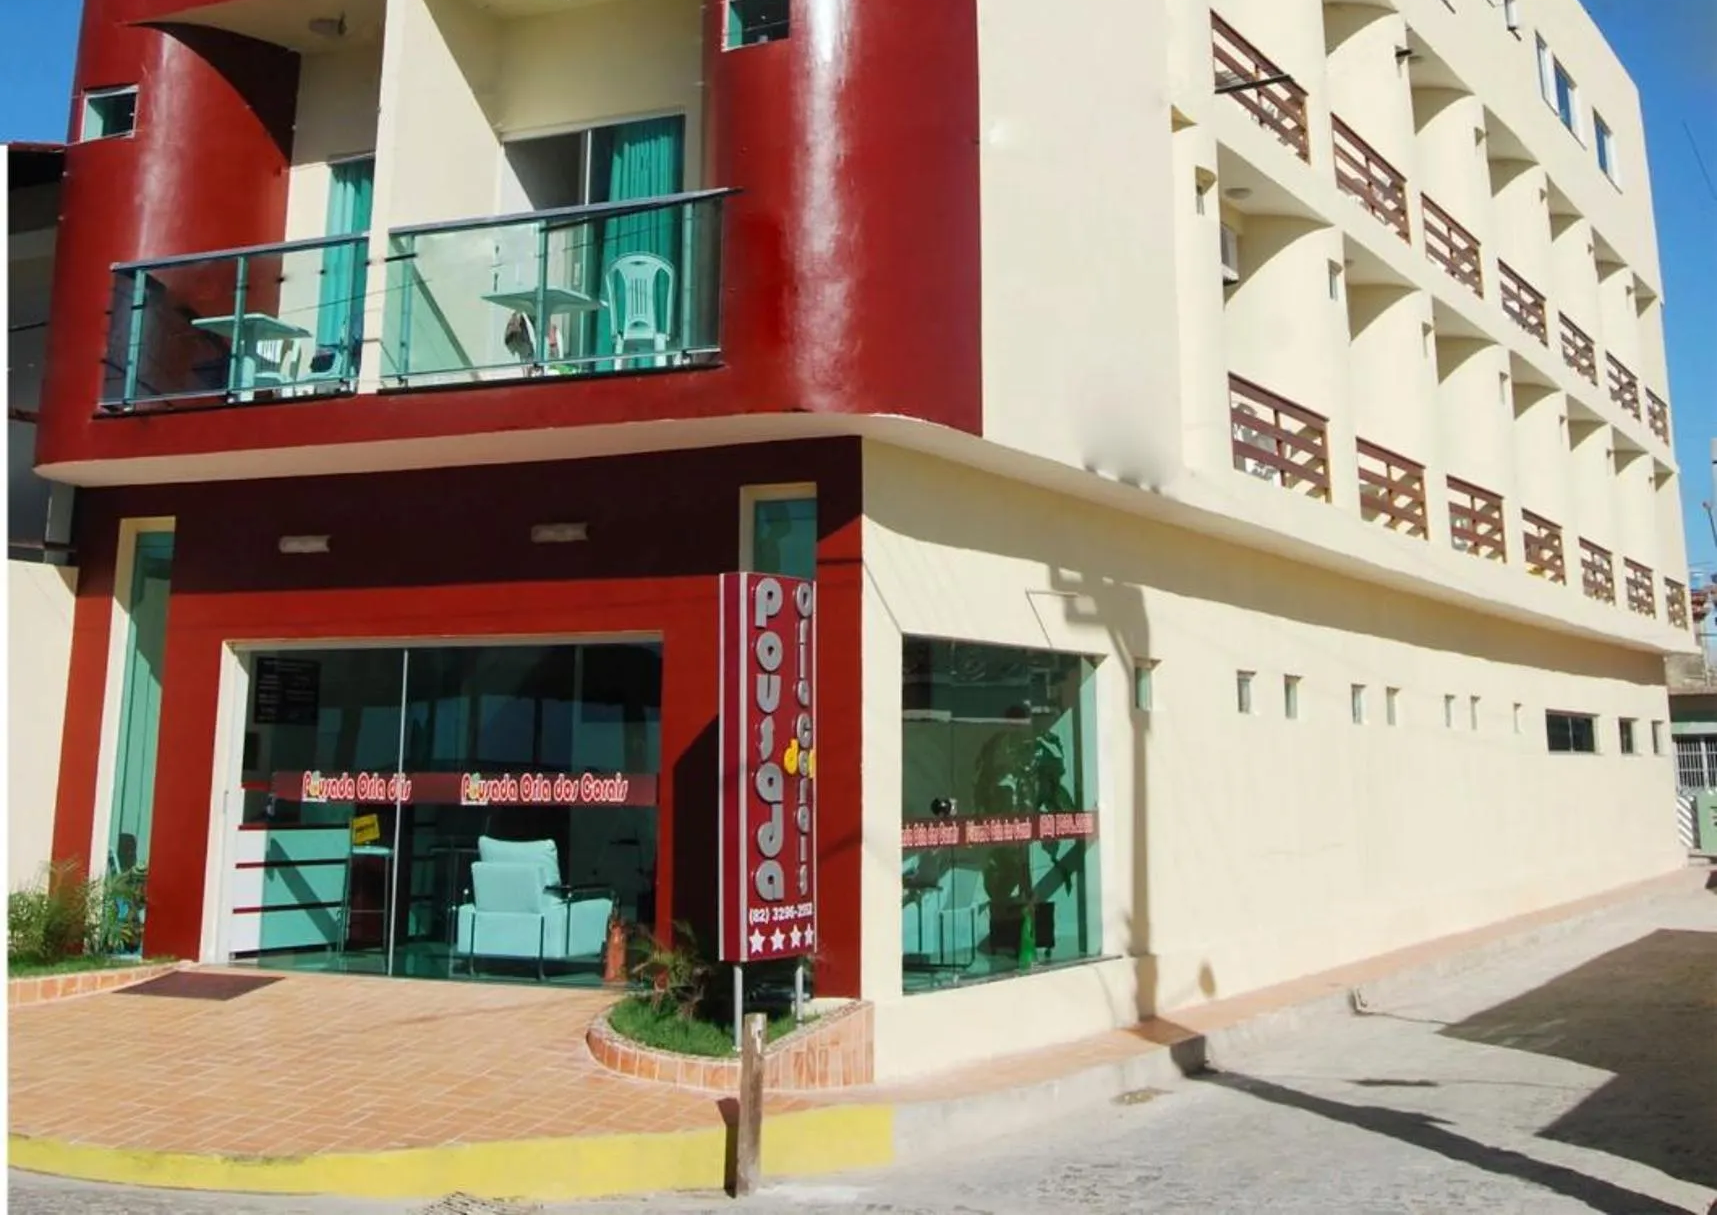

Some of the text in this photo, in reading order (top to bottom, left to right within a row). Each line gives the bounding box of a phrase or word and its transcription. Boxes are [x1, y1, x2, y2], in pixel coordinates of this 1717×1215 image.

[519, 773, 551, 802] Orla
[553, 773, 580, 802] dos
[581, 772, 629, 802] Corais
